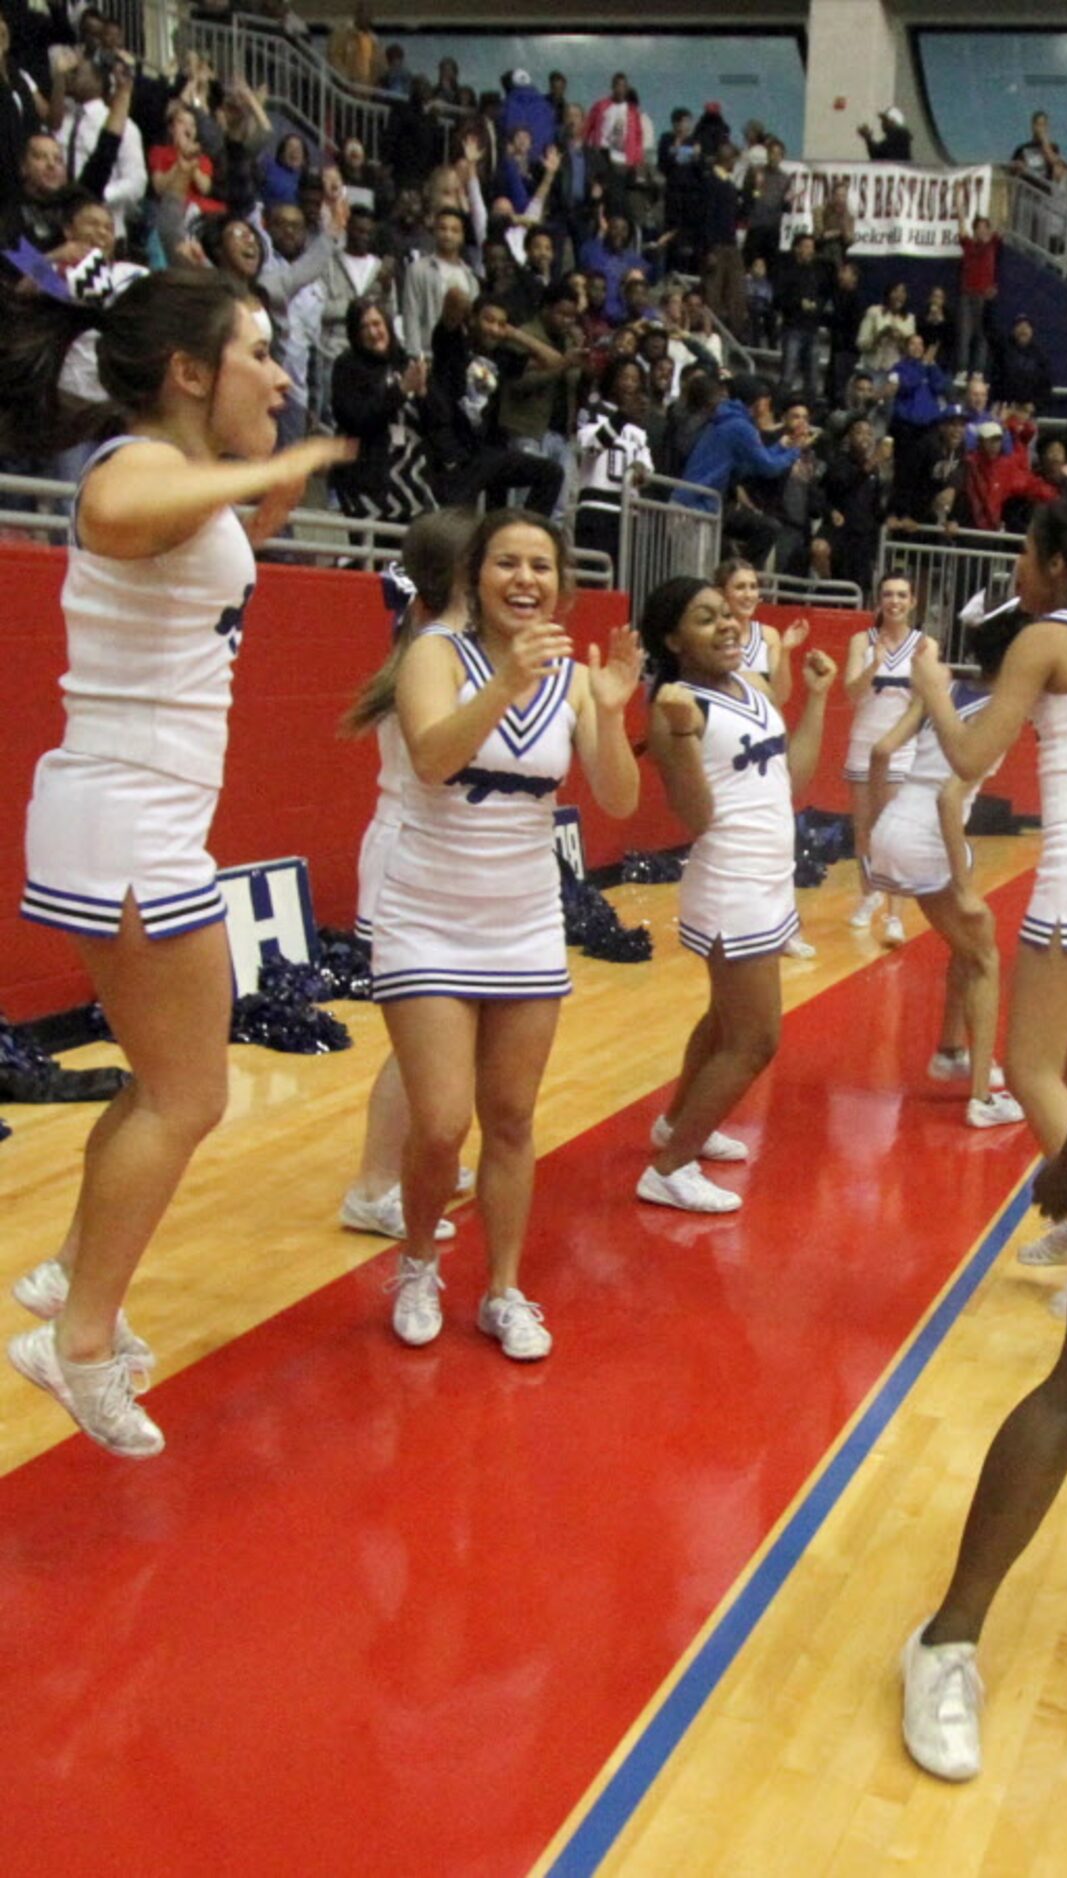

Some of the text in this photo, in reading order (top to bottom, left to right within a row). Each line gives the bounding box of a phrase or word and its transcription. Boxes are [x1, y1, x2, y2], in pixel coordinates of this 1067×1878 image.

[873, 173, 984, 222] RESTAURANT
[853, 225, 903, 244] ockrell
[216, 866, 310, 998] H
